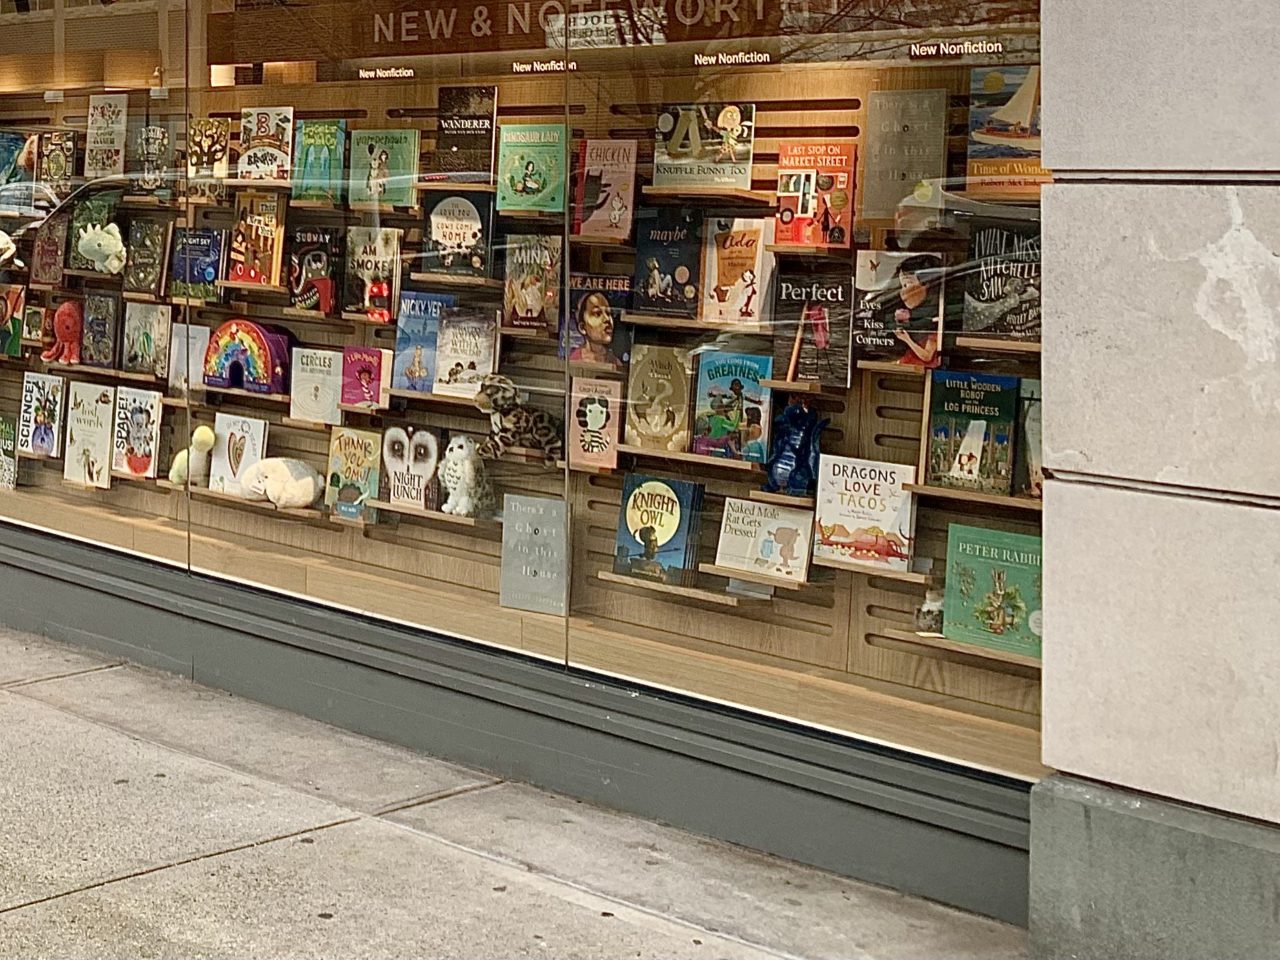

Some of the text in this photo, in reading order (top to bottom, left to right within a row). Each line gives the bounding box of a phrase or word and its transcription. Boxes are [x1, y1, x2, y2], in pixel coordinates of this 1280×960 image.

[373, 7, 457, 44] NEW
[470, 5, 492, 38] &
[911, 40, 1003, 57] New Nonfiction
[694, 50, 770, 65] New Nonfiction
[359, 66, 414, 78] New Nonfiction
[513, 62, 531, 73] New
[441, 119, 491, 129] WANDERER
[787, 145, 841, 155] LAST STOP ON
[782, 155, 848, 167] MARKET STREET
[972, 162, 997, 174] Time
[999, 162, 1012, 174] of
[260, 203, 276, 213] This
[201, 239, 211, 247] SKY
[295, 232, 331, 244] SUBWAY
[441, 231, 467, 242] HOME
[649, 226, 687, 246] maybe
[722, 233, 756, 250] Ada
[361, 245, 377, 256] AM
[512, 249, 550, 265] MINA
[350, 258, 389, 272] SMOKE
[980, 257, 1040, 284] MITCHELL
[569, 276, 630, 291] WE ARE HERE
[780, 282, 844, 303] Perfect
[401, 299, 426, 316] NICKY
[860, 300, 881, 311] Eyes
[864, 319, 884, 329] Kiss
[856, 334, 895, 346] Corners
[300, 354, 333, 369] CIRCLES
[945, 379, 1002, 392] LITTLE WOODEN
[960, 390, 985, 400] ROBOT
[19, 380, 33, 449] SCIENCE!
[944, 402, 1000, 417] LOG PRINCESS
[115, 396, 129, 451] SPACE!
[336, 434, 373, 455] THANK
[344, 452, 365, 467] YOU
[344, 465, 370, 485] OMU!
[393, 471, 423, 489] NIGHT
[832, 463, 897, 485] DRAGONS
[392, 483, 422, 502] LUNCH
[844, 479, 881, 496] LOVE
[631, 492, 677, 517] KNIGHT
[836, 492, 887, 513] TACOS
[639, 509, 665, 529] OWL
[728, 501, 781, 521] Naked Mole
[725, 514, 762, 530] Rat Gets
[723, 523, 758, 539] Dressed
[958, 542, 1042, 567] PETER RABBI
